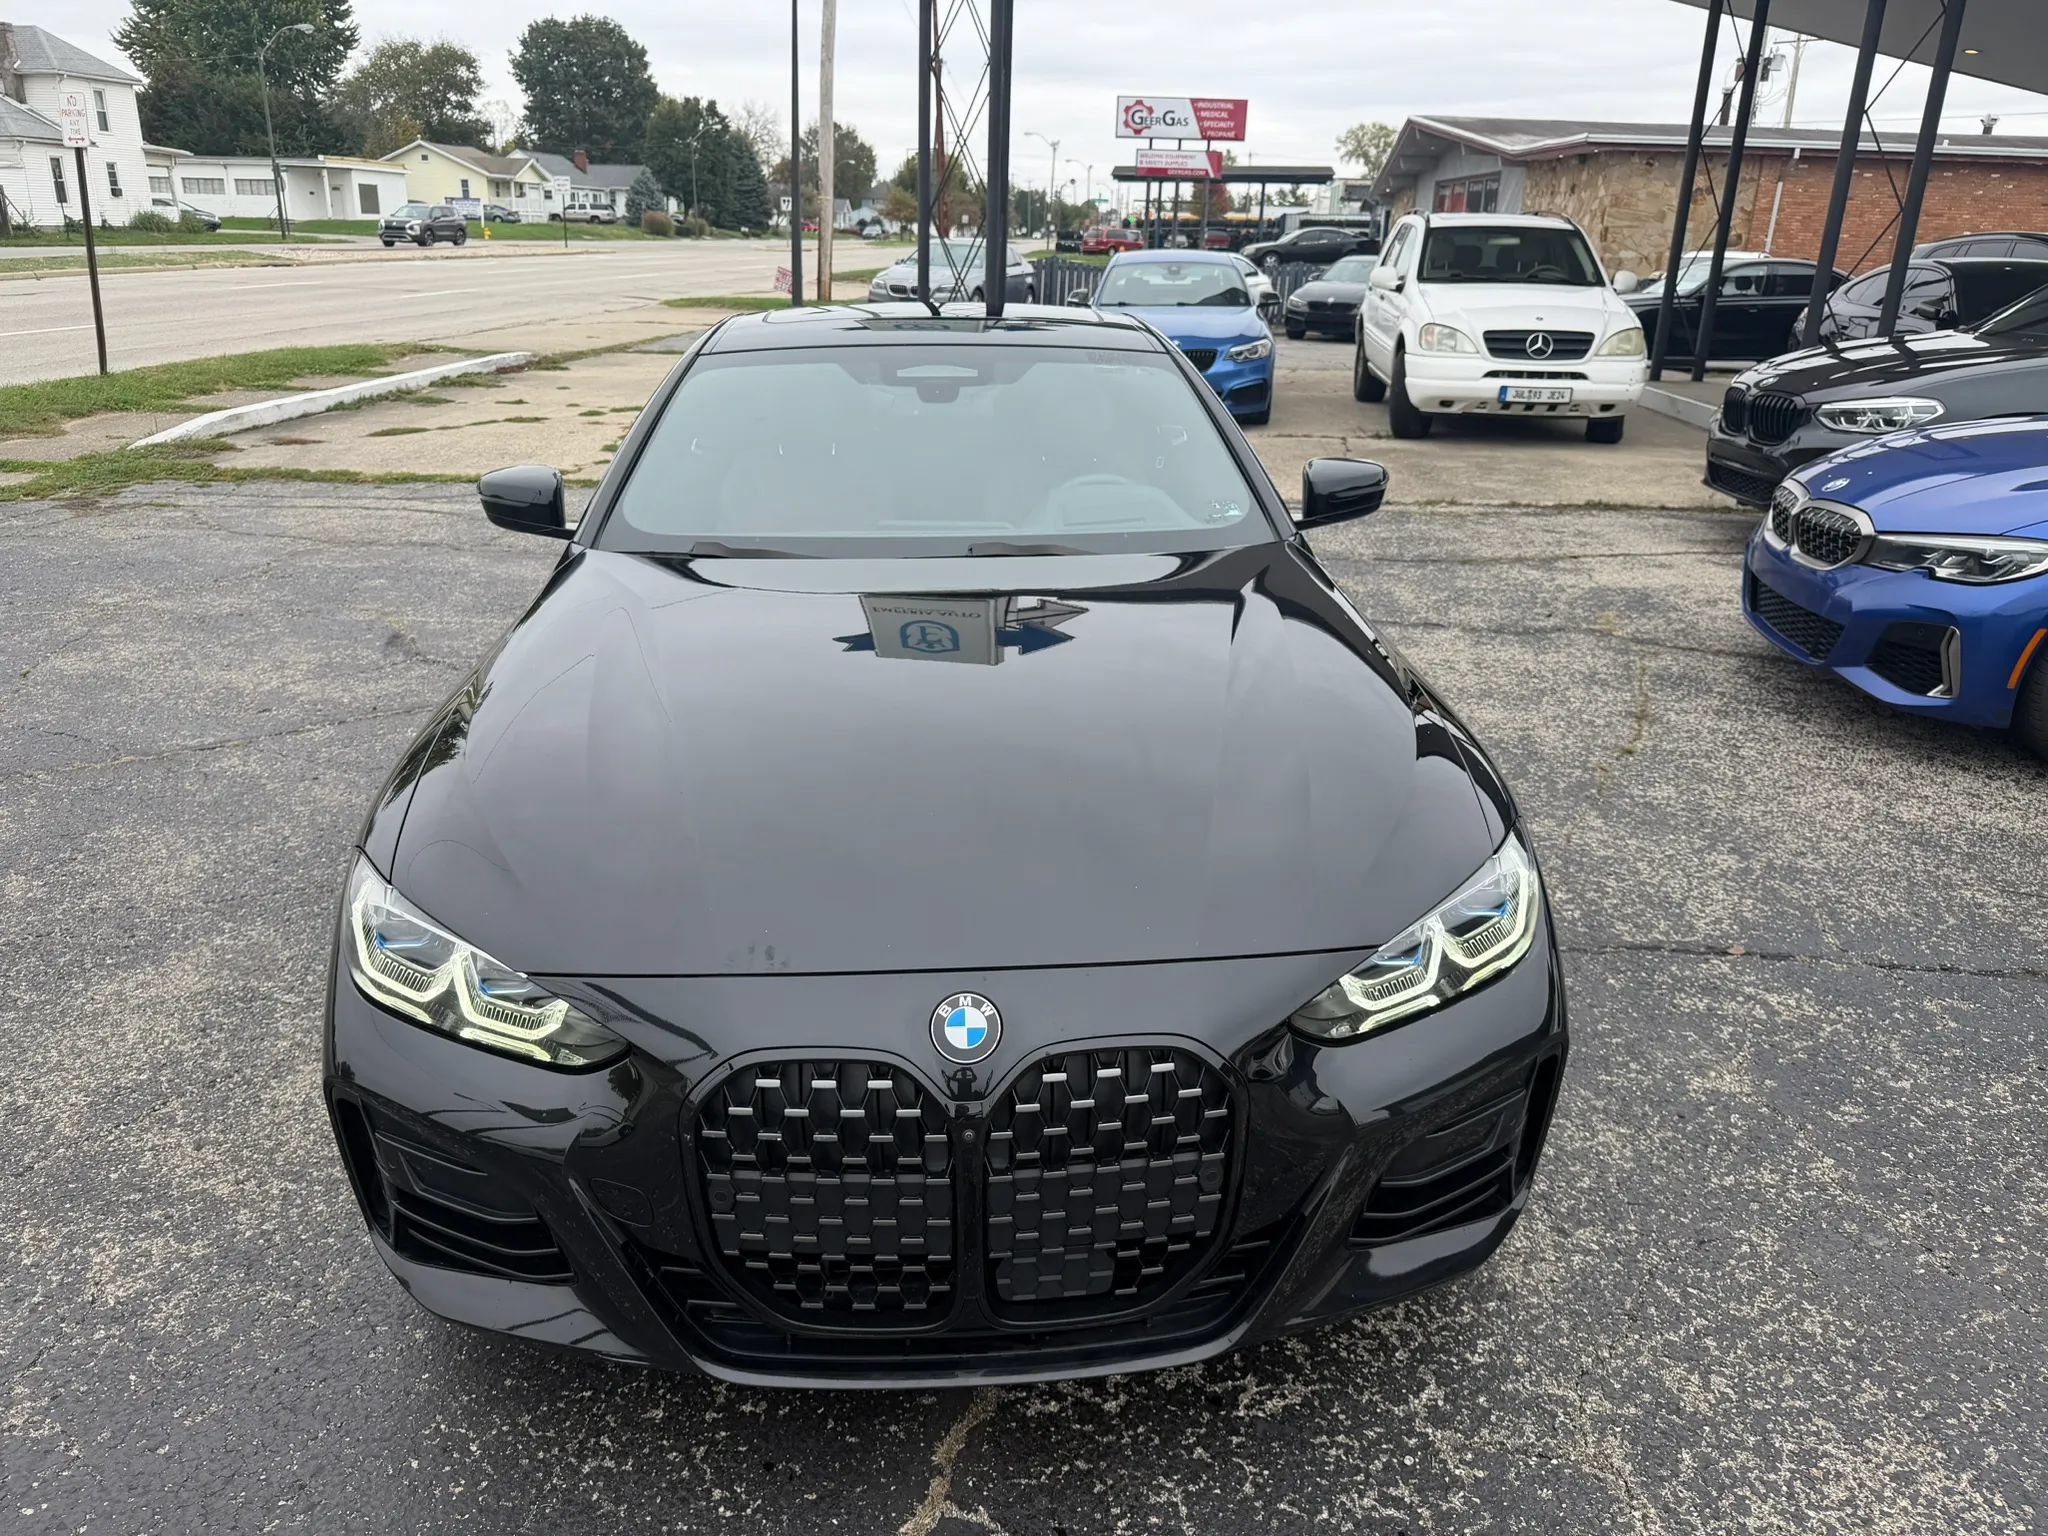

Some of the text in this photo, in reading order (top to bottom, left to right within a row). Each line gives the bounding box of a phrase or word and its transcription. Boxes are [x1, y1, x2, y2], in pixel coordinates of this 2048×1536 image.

[67, 96, 77, 107] NO
[62, 108, 86, 117] PARKING
[938, 996, 994, 1018] BMW
